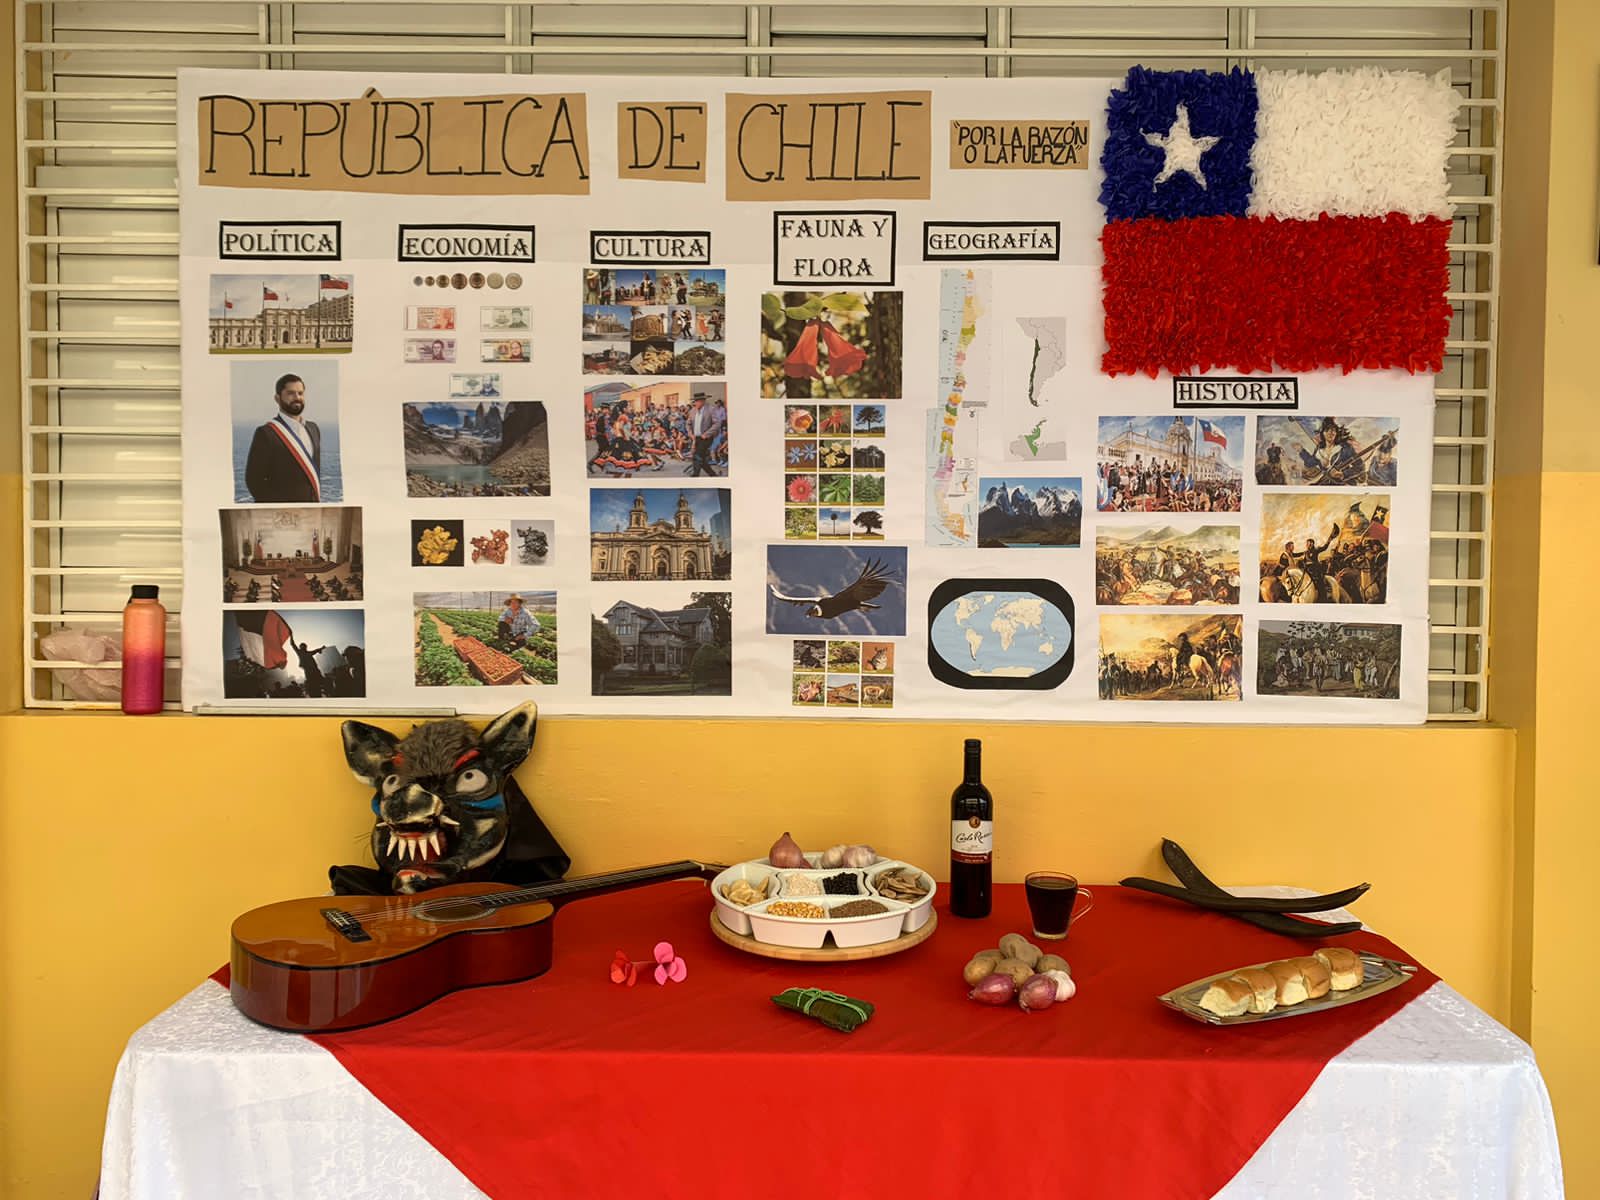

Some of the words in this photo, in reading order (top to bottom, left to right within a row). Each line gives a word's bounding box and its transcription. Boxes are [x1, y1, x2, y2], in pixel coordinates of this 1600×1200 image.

[199, 87, 589, 179] REPÚBLICA
[627, 106, 703, 170] DE
[737, 101, 923, 182] CHILE
[1000, 126, 1023, 148] LA
[964, 144, 977, 164] O
[780, 219, 864, 239] FAUNA
[872, 217, 889, 238] Y
[929, 228, 1055, 250] GEOGRAFÍA
[224, 229, 334, 253] POLÍTICA
[405, 233, 530, 257] ECONOMÍA
[595, 238, 706, 258] CULTURA
[793, 258, 873, 278] FLORA
[1179, 382, 1293, 402] HISTORIA
